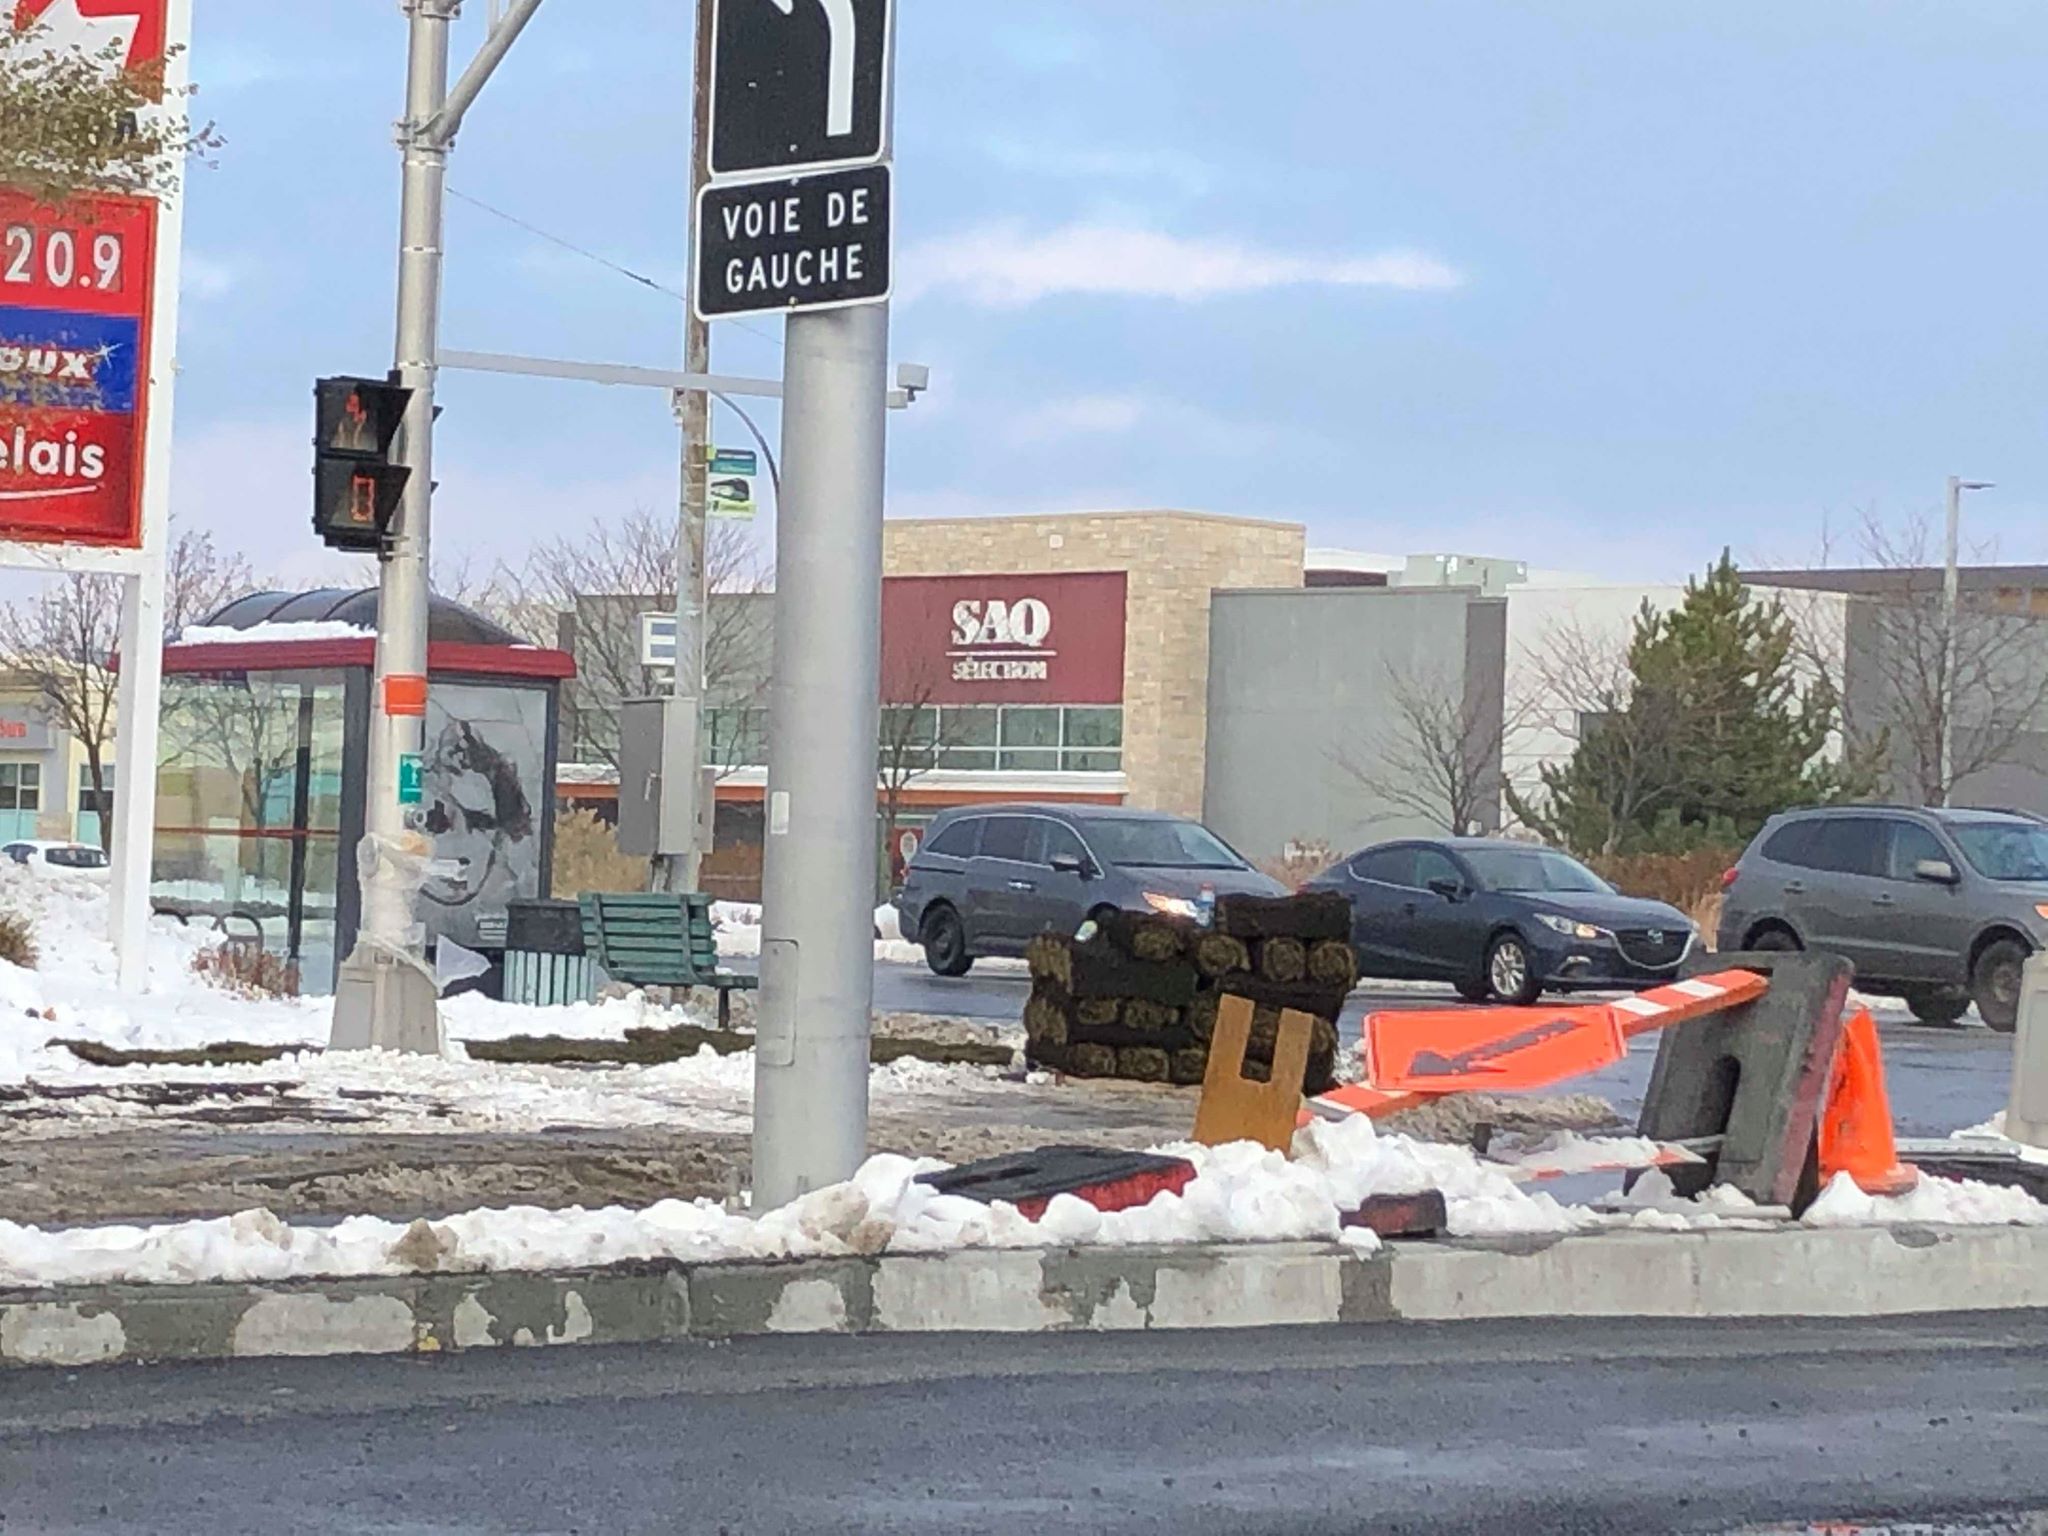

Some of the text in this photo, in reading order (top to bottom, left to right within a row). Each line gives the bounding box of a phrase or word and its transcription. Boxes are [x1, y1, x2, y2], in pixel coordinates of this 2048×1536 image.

[722, 188, 868, 240] VOIE DE
[4, 227, 120, 289] 20.9
[726, 243, 863, 293] GAUCHE
[951, 598, 1050, 647] SAQ
